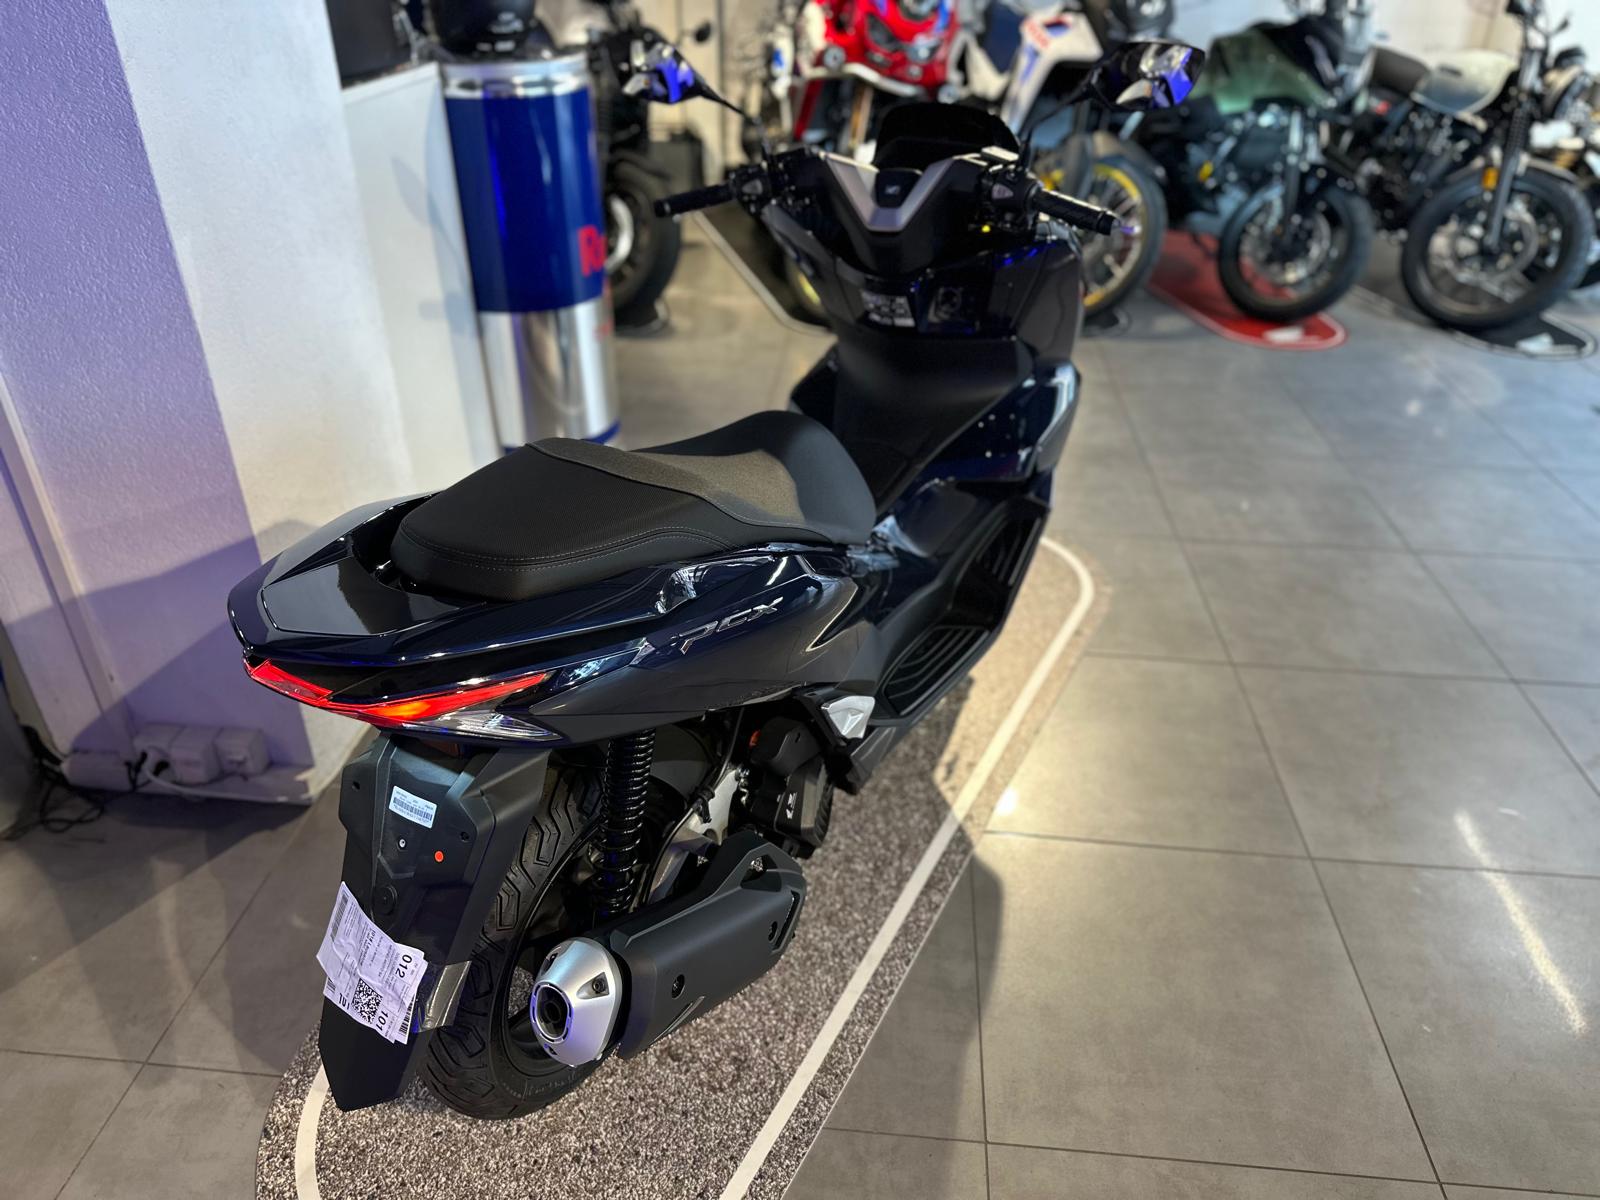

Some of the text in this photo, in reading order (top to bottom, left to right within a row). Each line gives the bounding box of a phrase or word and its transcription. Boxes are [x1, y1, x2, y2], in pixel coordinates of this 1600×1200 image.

[680, 596, 784, 655] PCX
[395, 954, 412, 978] 012
[376, 1010, 389, 1031] 101
